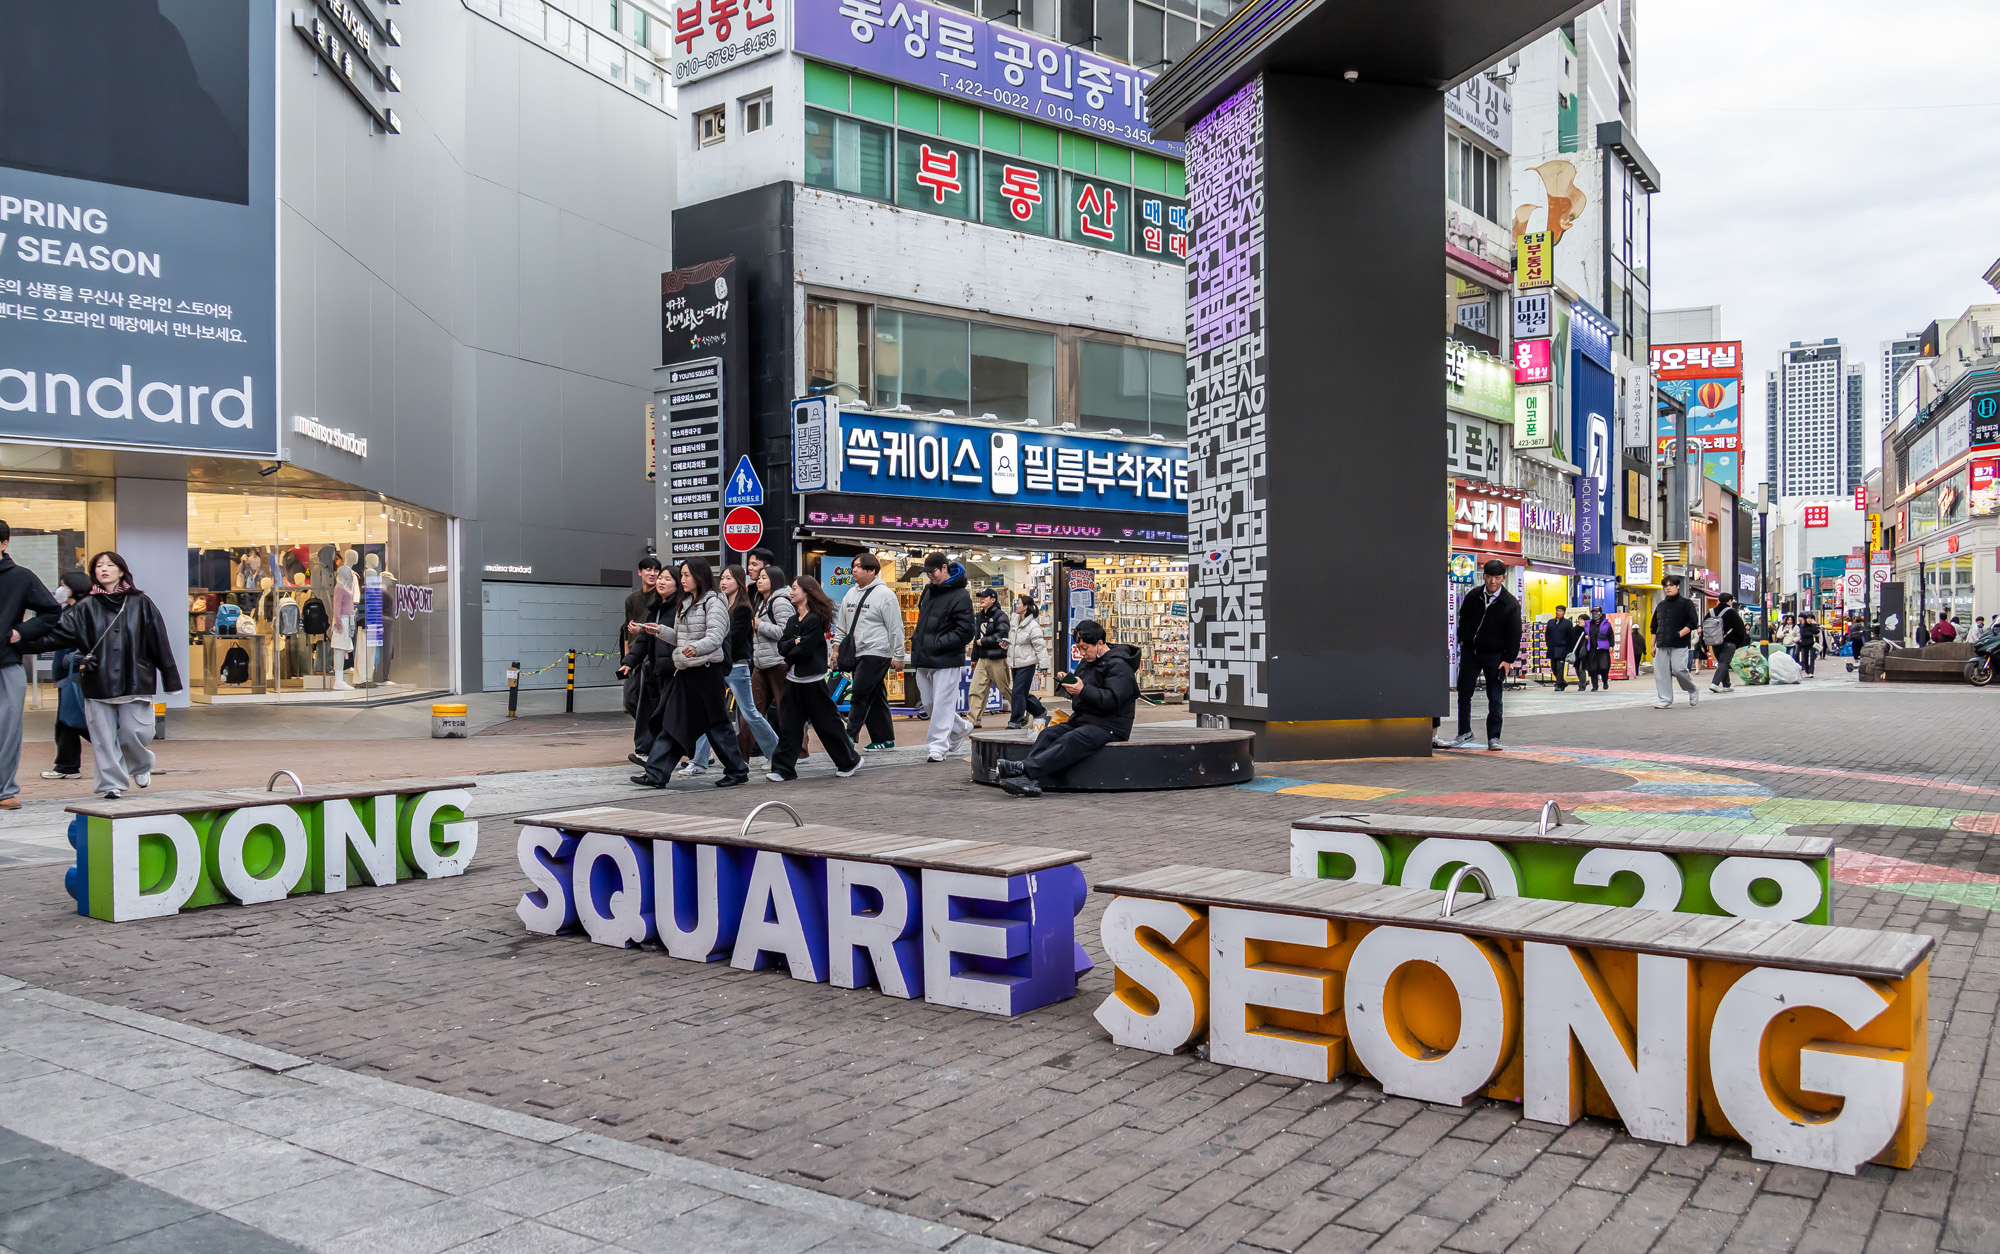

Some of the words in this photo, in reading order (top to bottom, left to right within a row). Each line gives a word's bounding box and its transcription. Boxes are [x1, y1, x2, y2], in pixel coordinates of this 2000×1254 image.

[676, 29, 777, 79] 010-6799-3456
[838, 0, 978, 71] 동성로
[938, 72, 1030, 111] T.422-0022
[1486, 124, 1499, 140] SHOP
[916, 143, 1118, 242] 부동산
[17, 235, 161, 278] SEASON
[1527, 243, 1542, 280] 부동산
[26, 280, 74, 302] 상품을
[78, 288, 124, 308] 무신사
[128, 293, 172, 314] 온라인
[176, 299, 233, 320] 스토어와
[42, 307, 105, 329] 오프라인
[109, 315, 168, 336] 매장에서
[173, 322, 248, 344] 만나보세요.
[1516, 343, 1533, 369] 홍
[1526, 396, 1537, 436] 에코폰
[333, 428, 367, 458] standard
[798, 425, 821, 446] 필름
[1518, 438, 1545, 446] 423-3877
[798, 445, 821, 464] 부착
[799, 463, 822, 483] 전문
[839, 427, 983, 485] 쓱케이스
[1582, 478, 1592, 514] HOLIKA
[728, 525, 758, 533] 진입금지
[1582, 516, 1592, 553] HOLIKA
[395, 583, 434, 620] JANSPORT
[111, 788, 478, 922] DONG
[515, 826, 1014, 1016] SQUARE
[1093, 895, 1905, 1175] SEONG
